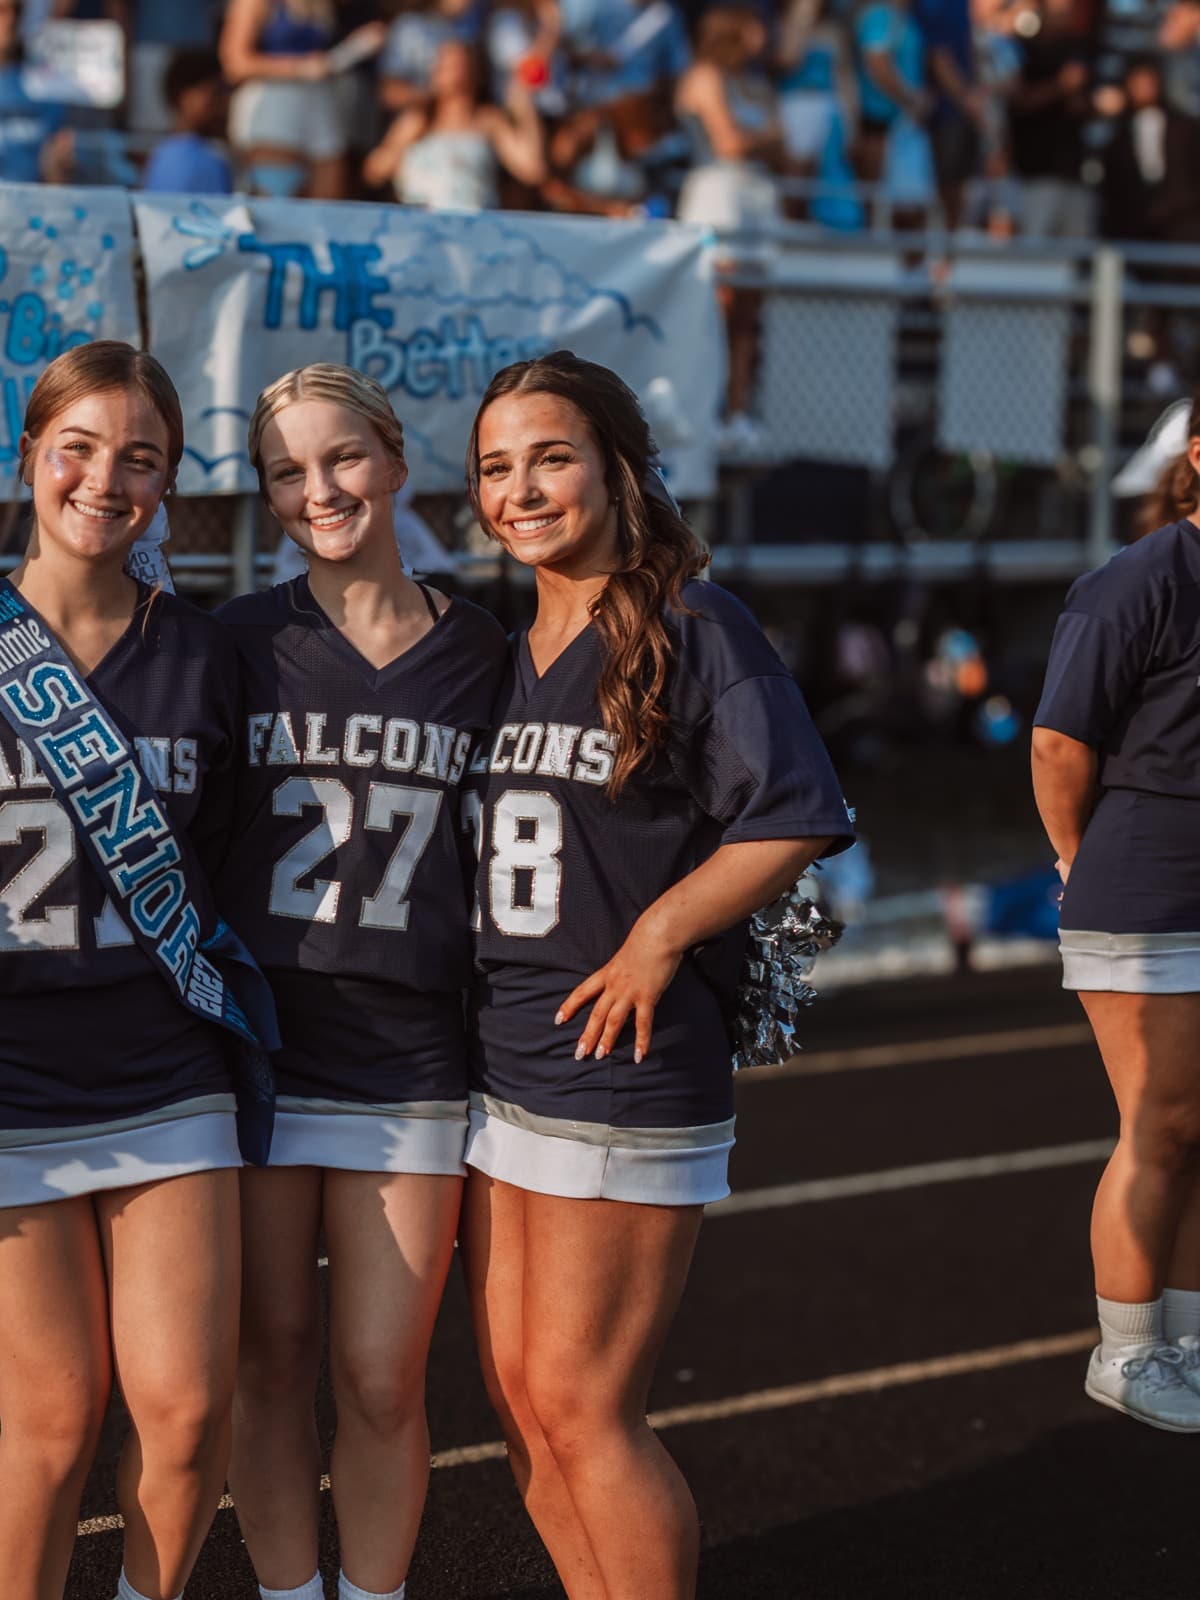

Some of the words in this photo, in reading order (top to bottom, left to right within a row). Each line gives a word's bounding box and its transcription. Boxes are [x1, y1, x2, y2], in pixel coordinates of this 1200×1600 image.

[250, 238, 395, 332] THE
[247, 711, 472, 785] FALCONS
[468, 721, 620, 786] LCONS
[268, 776, 443, 931] 27
[187, 950, 223, 1018] 2027
